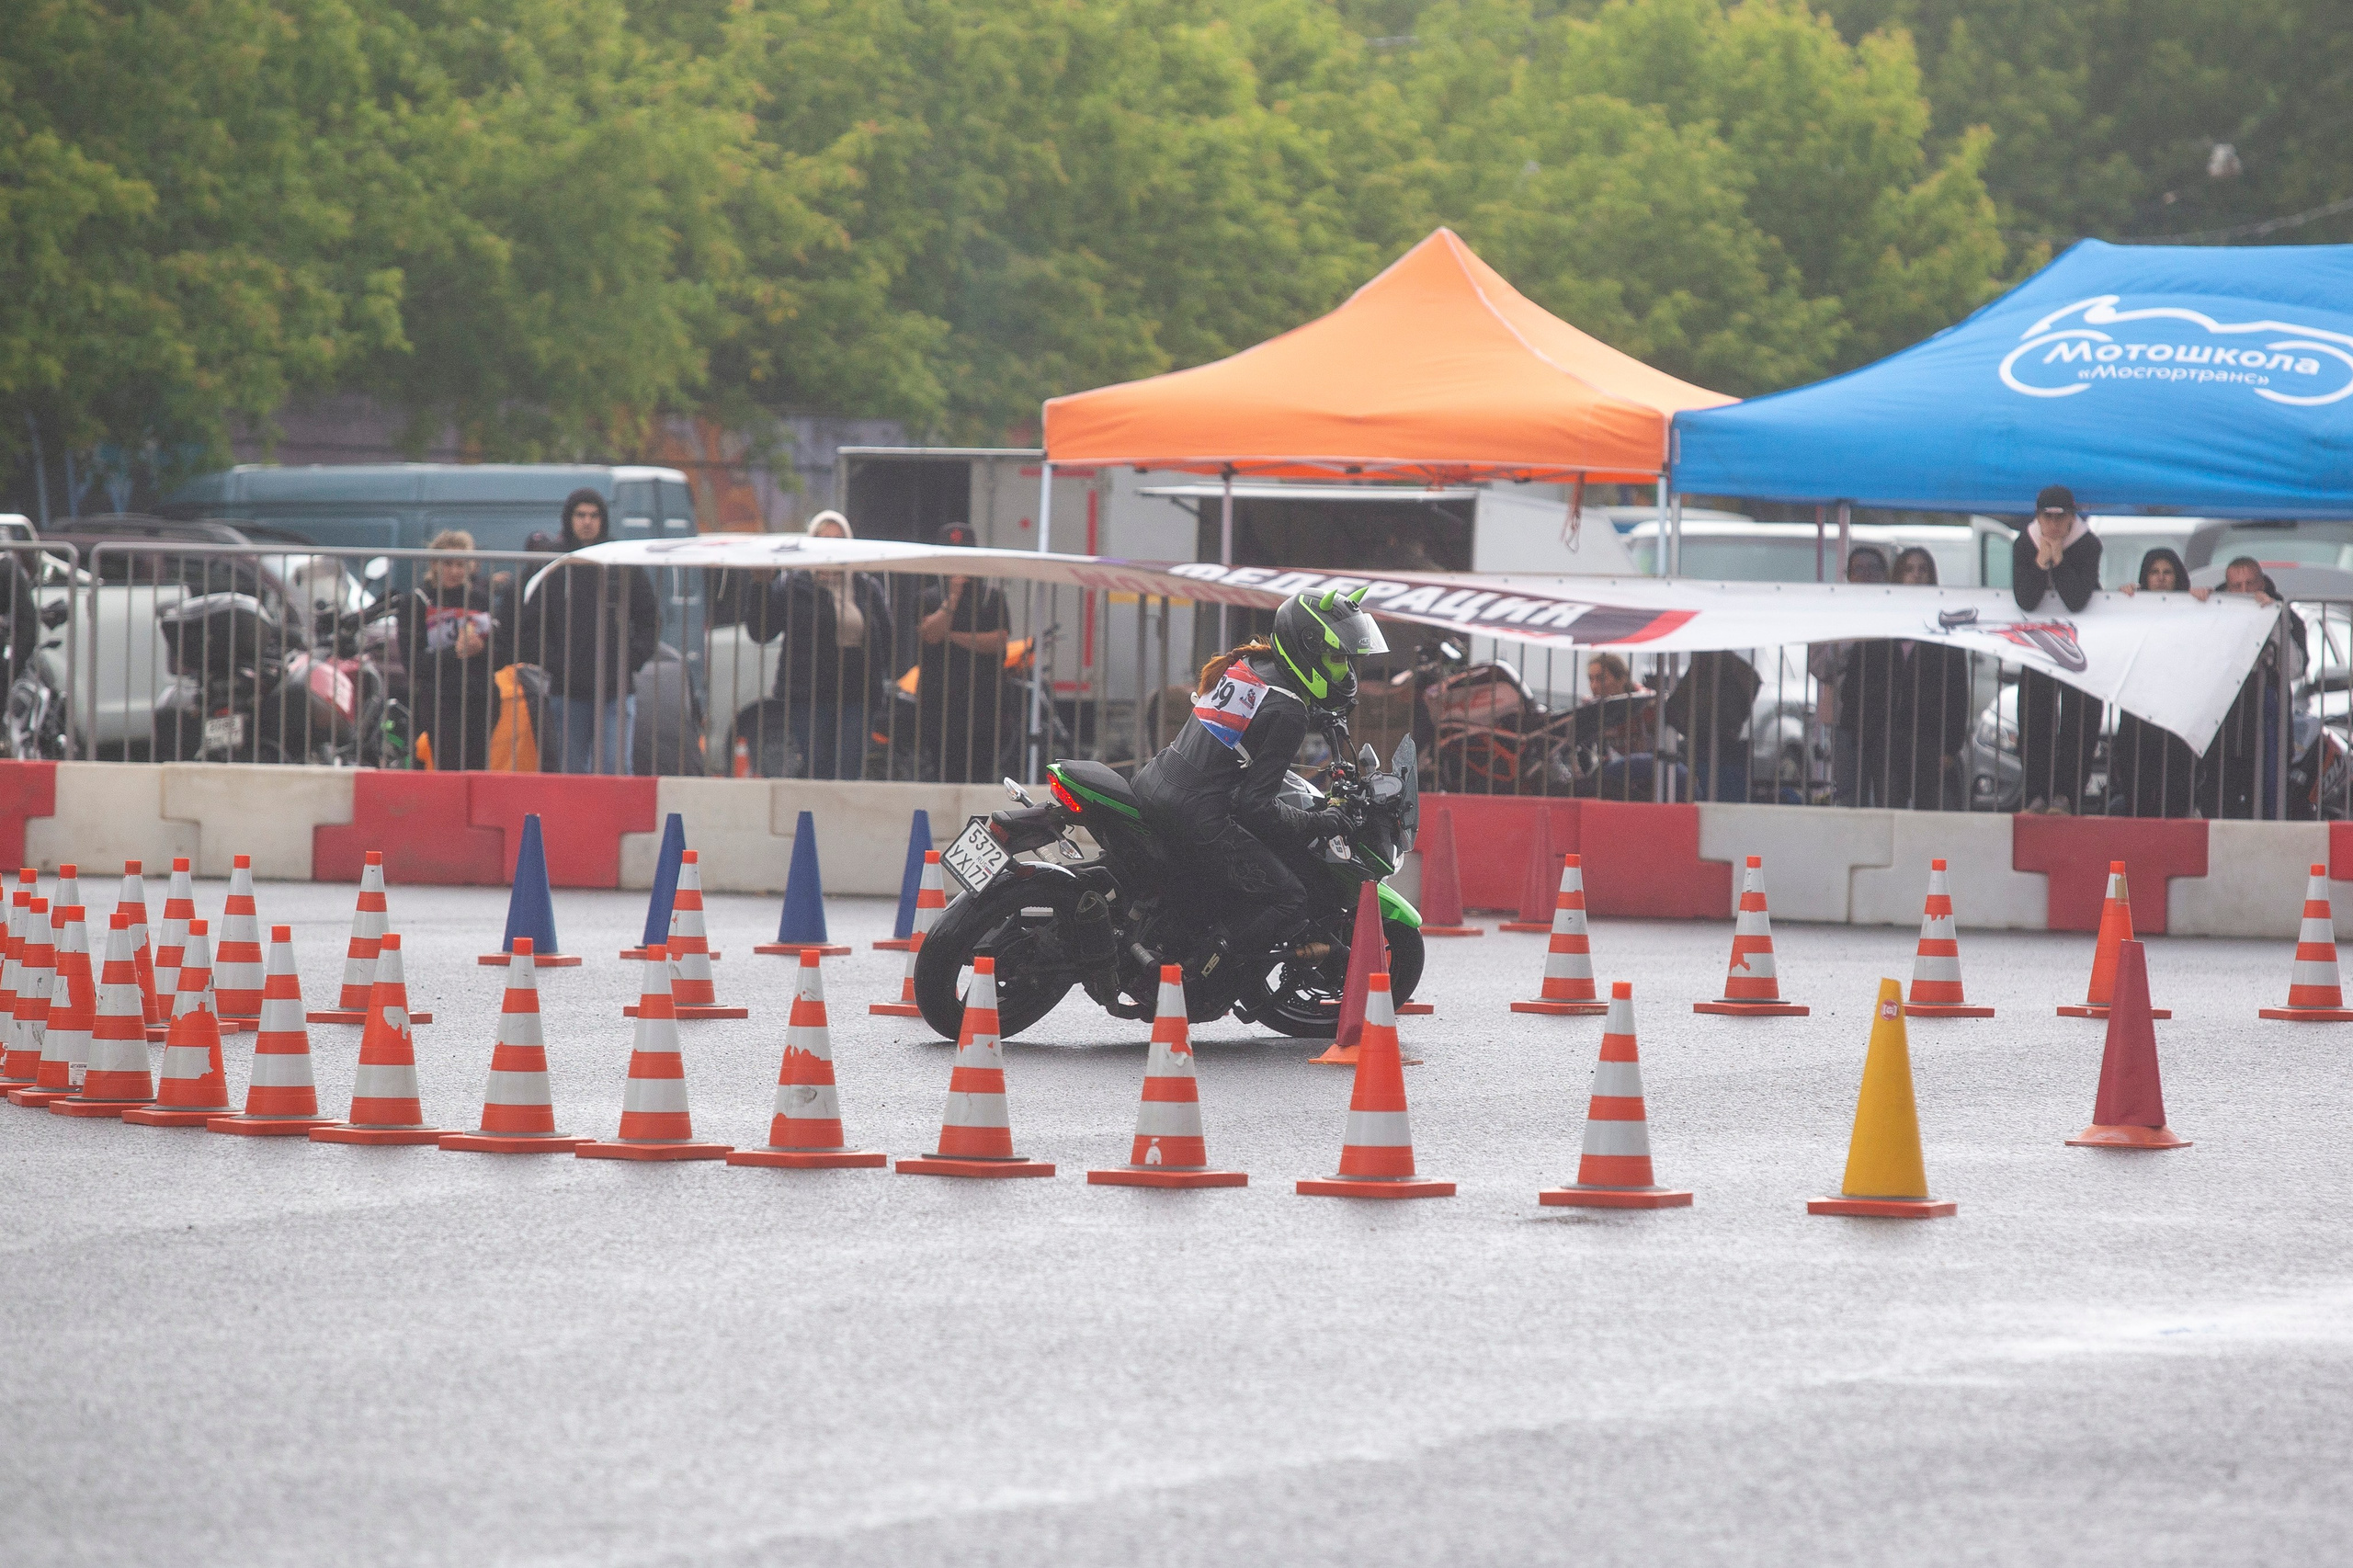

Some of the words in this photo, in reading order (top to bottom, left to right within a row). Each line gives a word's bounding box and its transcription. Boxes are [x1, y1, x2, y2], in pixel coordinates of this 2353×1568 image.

[2042, 339, 2322, 376] Мотошкола
[969, 828, 1002, 867] 5372
[975, 856, 987, 869] RUS
